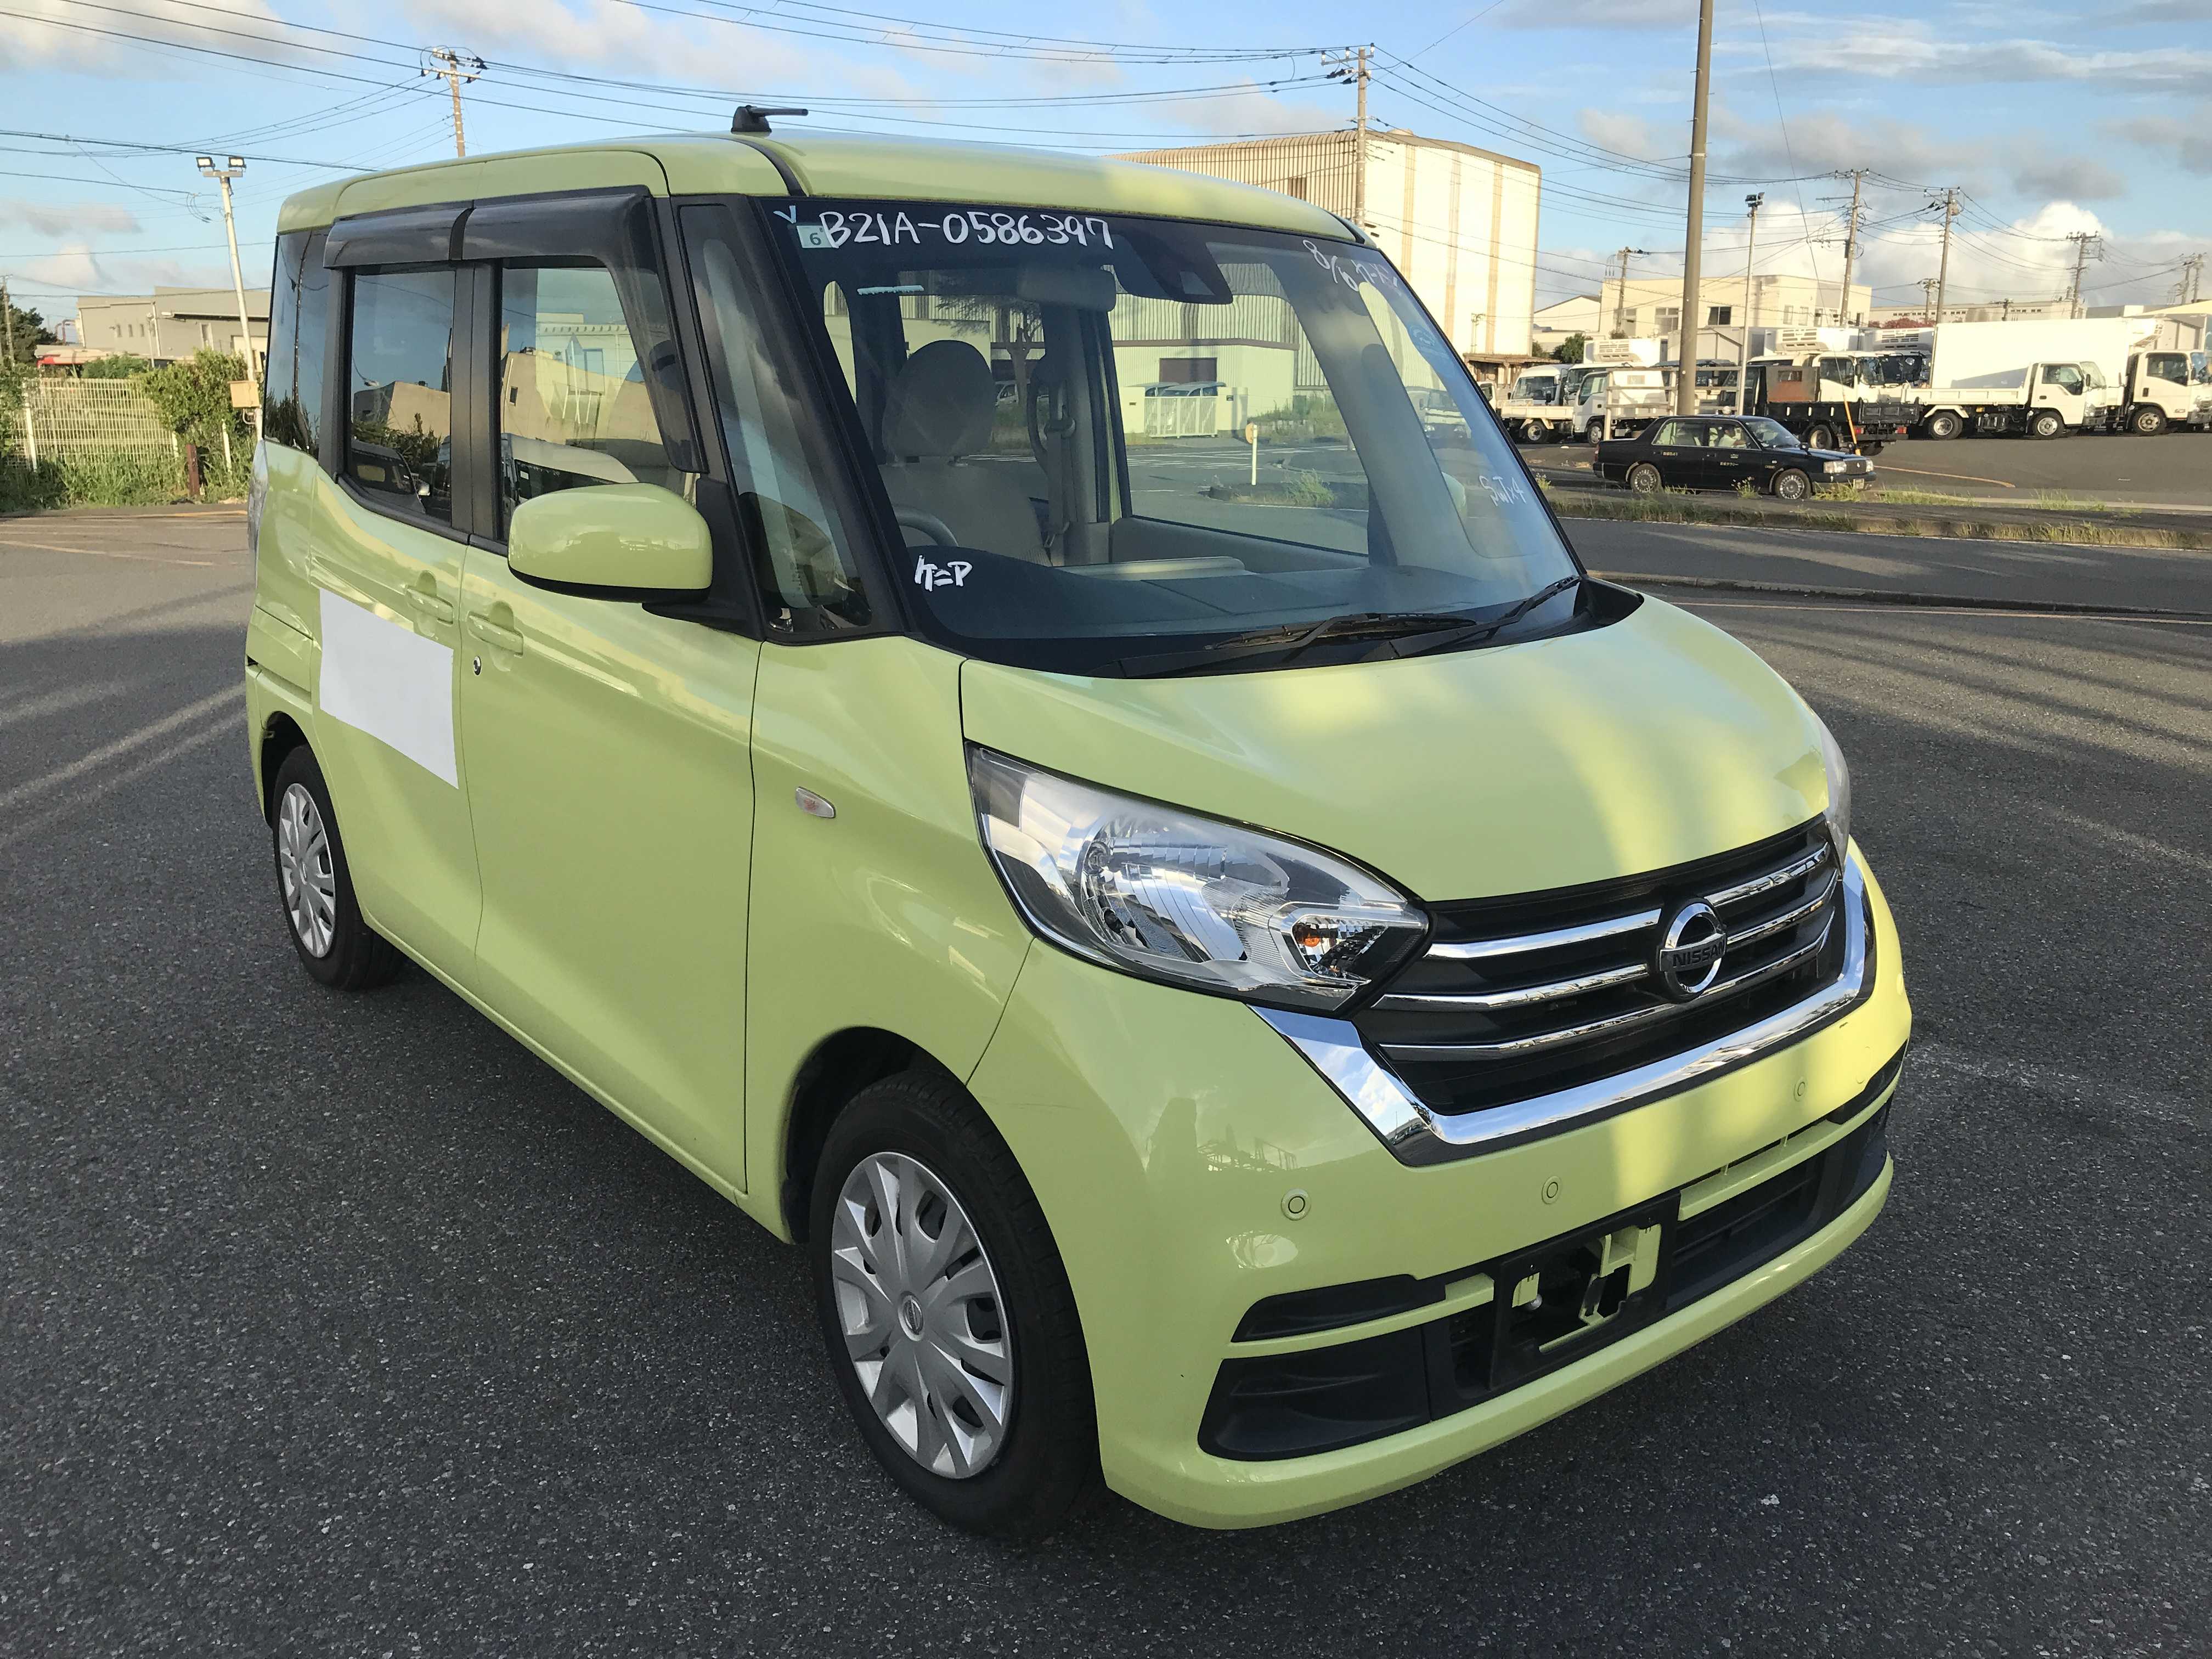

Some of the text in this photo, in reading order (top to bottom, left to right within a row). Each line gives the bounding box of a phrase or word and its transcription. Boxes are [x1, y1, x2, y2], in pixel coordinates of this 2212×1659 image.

[809, 232, 822, 246] 6
[819, 210, 1114, 250] B21A-0586397
[1672, 941, 1725, 968] NISSAN
